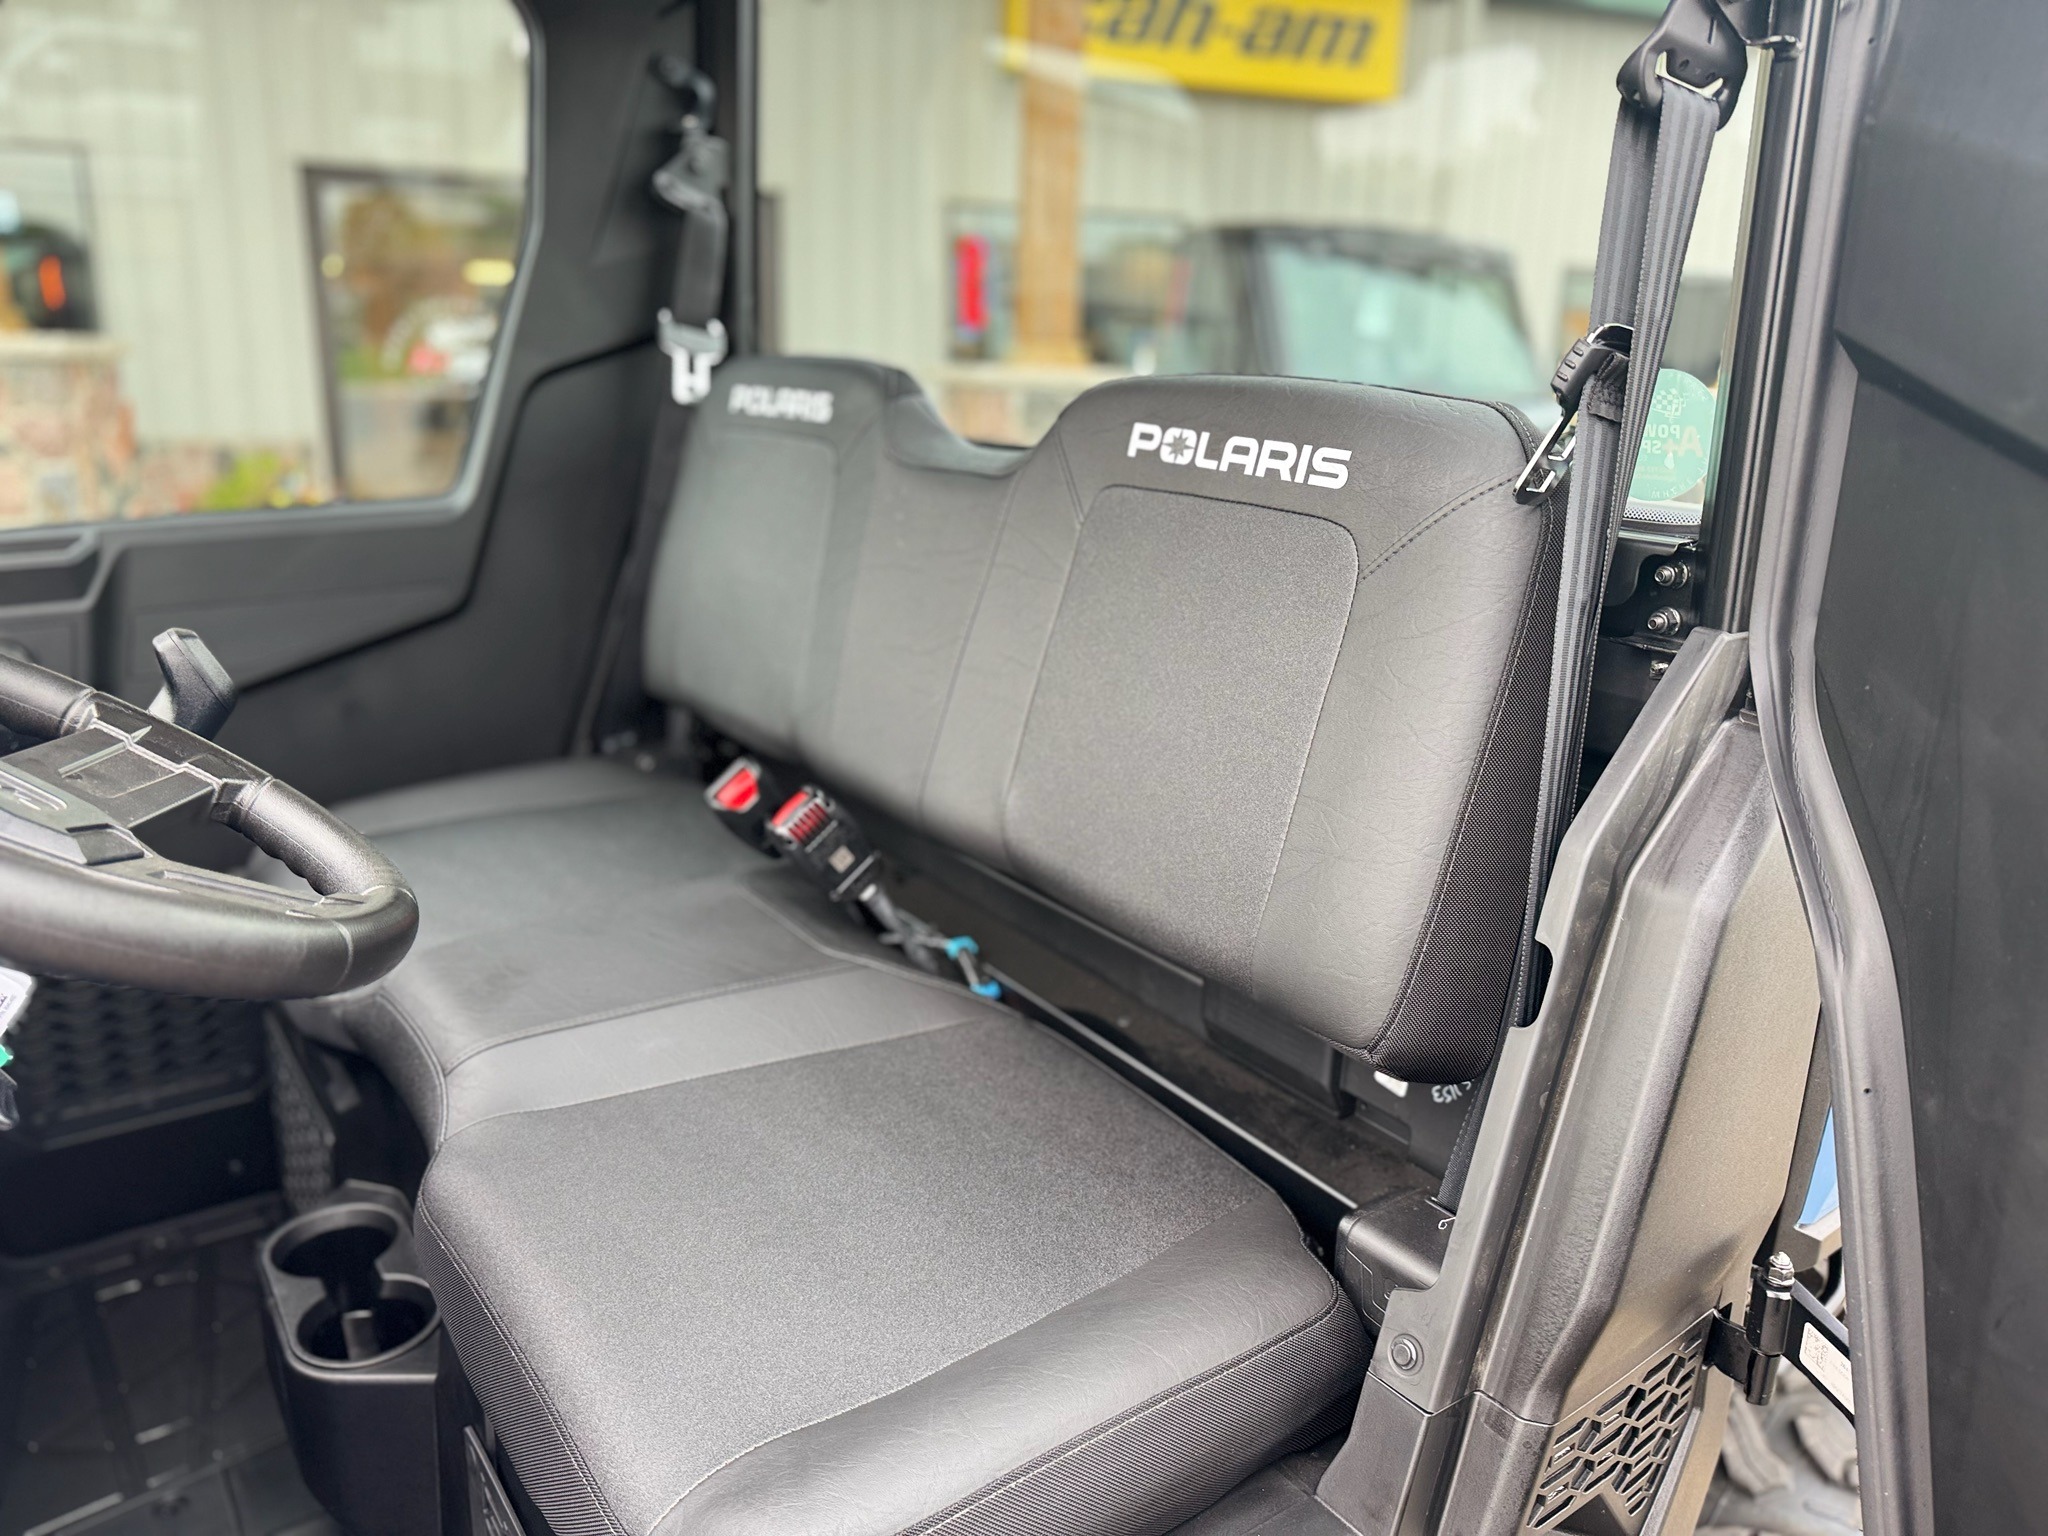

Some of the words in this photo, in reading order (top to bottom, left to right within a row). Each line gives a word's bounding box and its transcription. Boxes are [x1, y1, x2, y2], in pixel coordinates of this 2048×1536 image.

[1082, 0, 1378, 71] an-am
[727, 383, 834, 424] POLARIS
[1127, 421, 1353, 490] POLARIS
